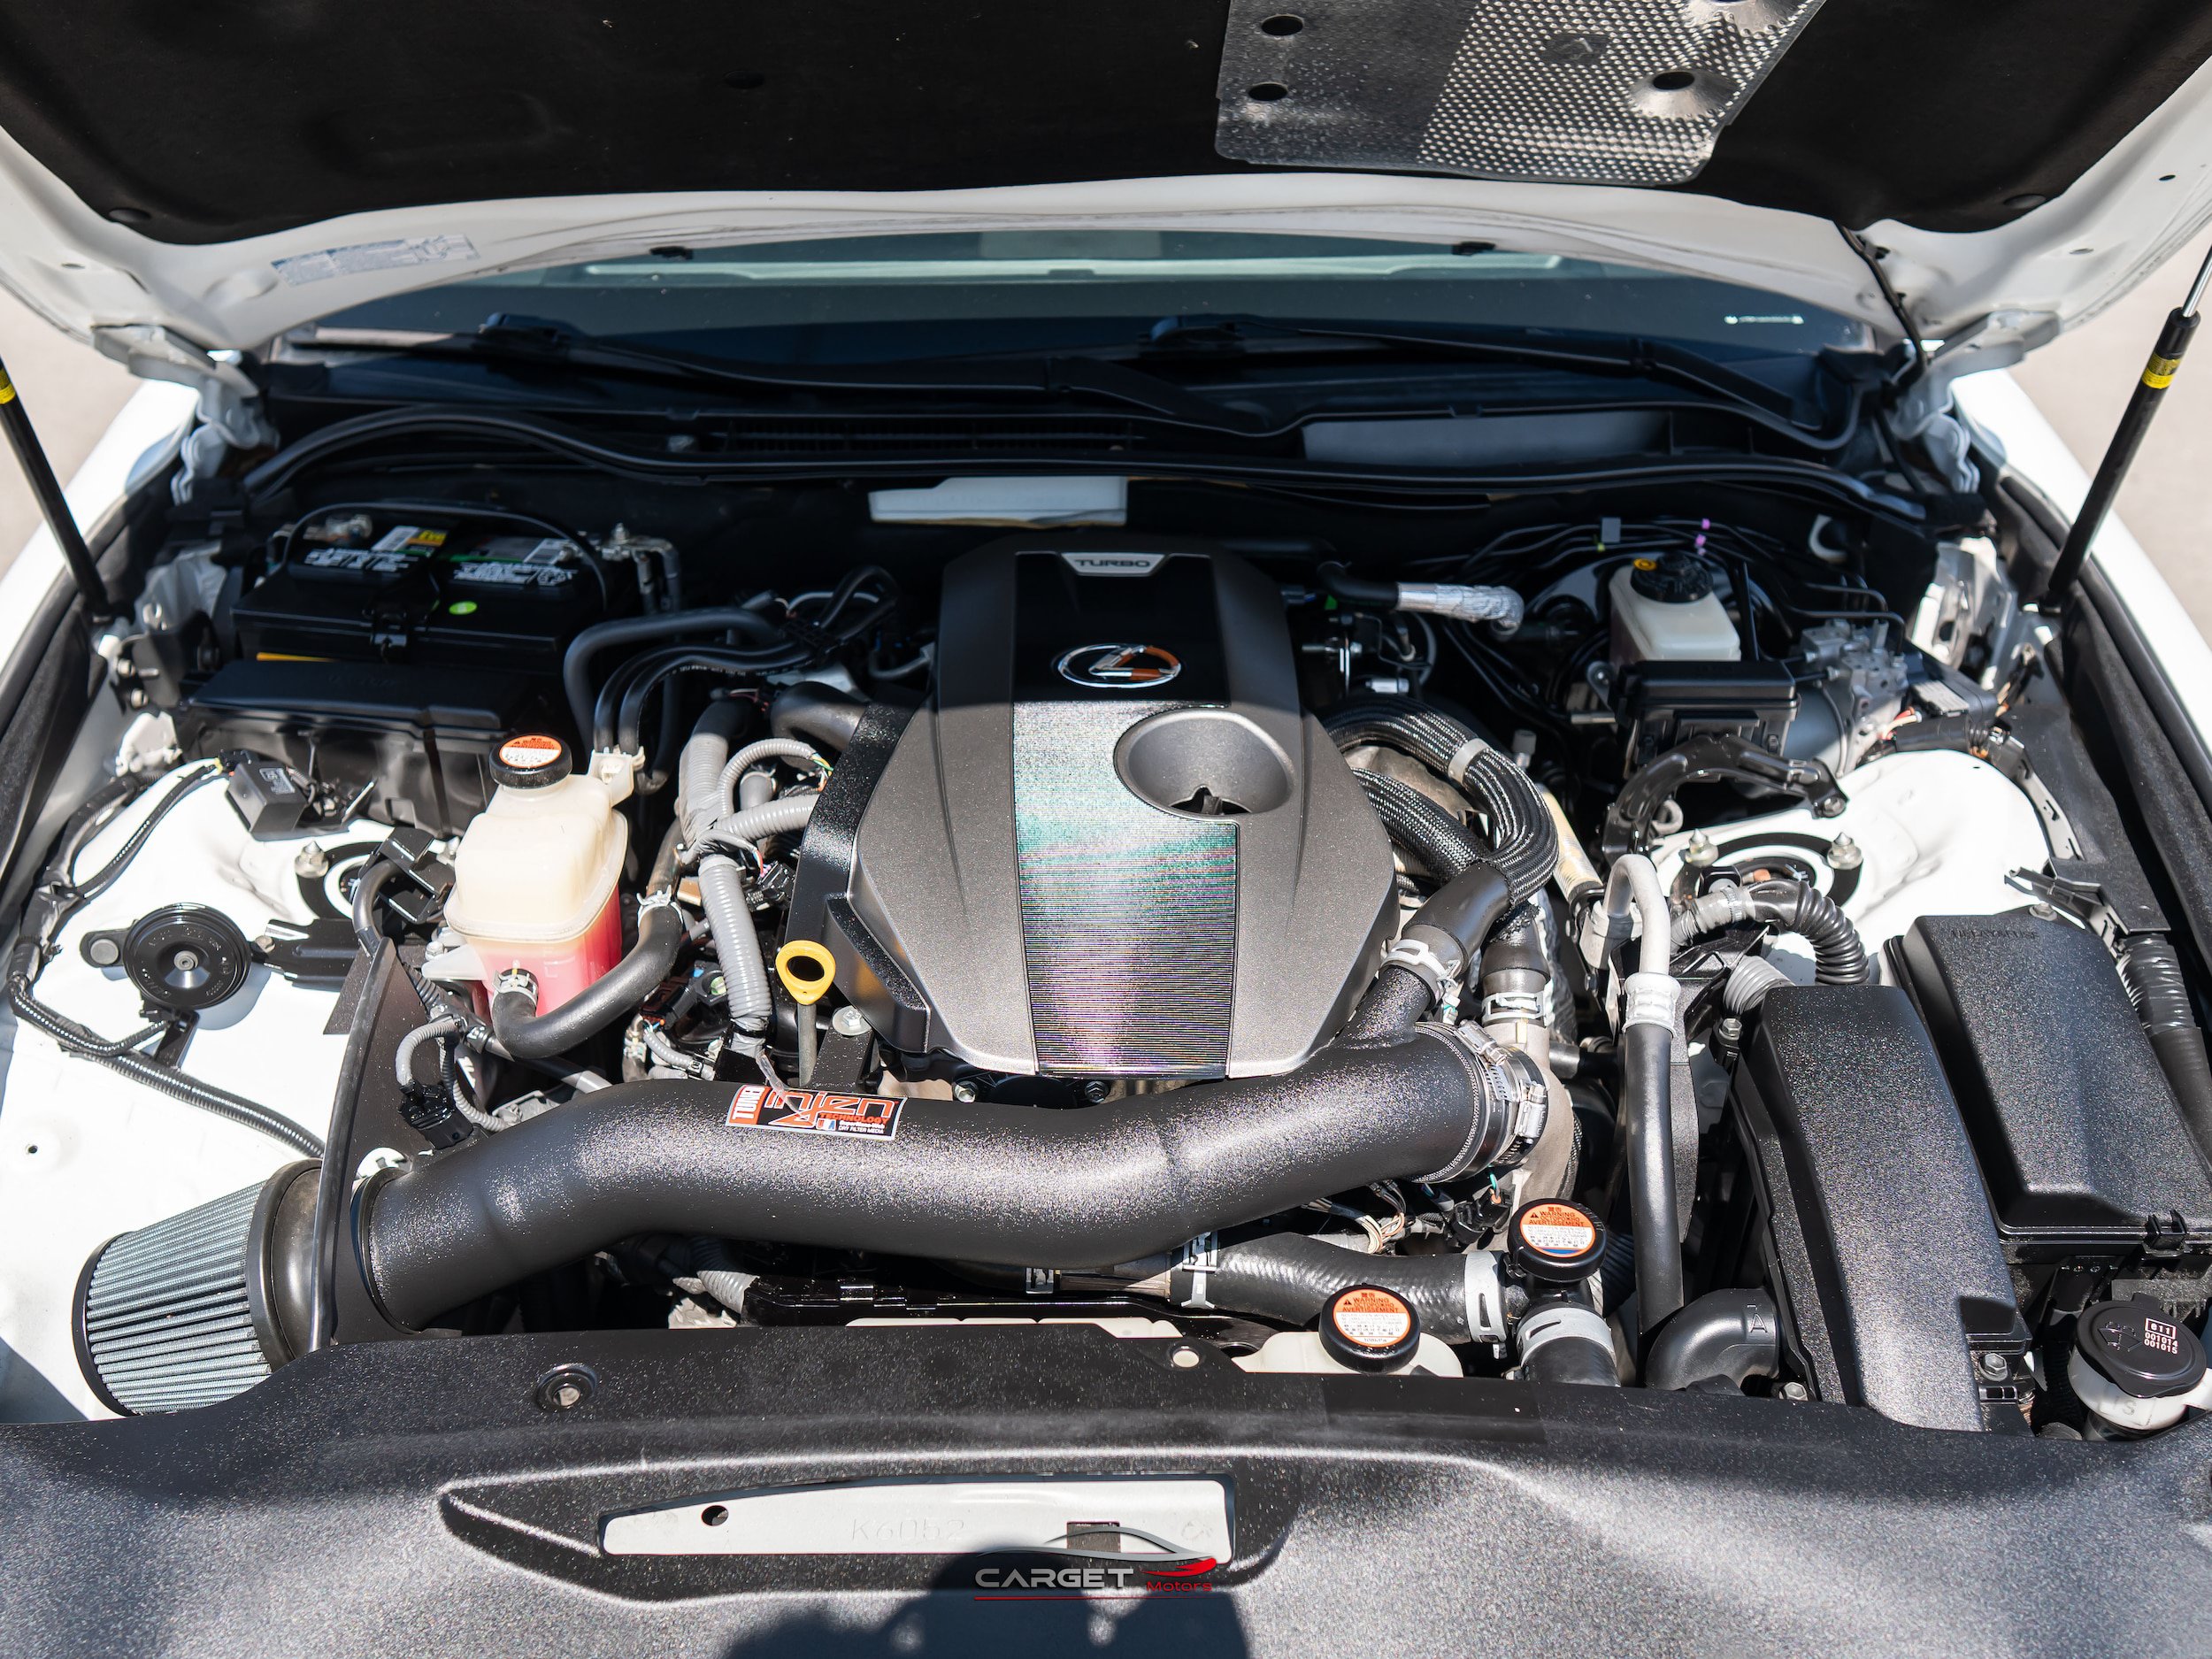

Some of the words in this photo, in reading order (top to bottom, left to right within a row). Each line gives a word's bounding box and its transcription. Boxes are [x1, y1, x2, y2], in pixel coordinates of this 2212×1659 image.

[818, 1118, 835, 1131] UA
[819, 1112, 890, 1125] TECHNOLOGY
[2144, 1339, 2177, 1355] 001015
[2145, 1332, 2178, 1347] 001014
[852, 1518, 964, 1541] K6052
